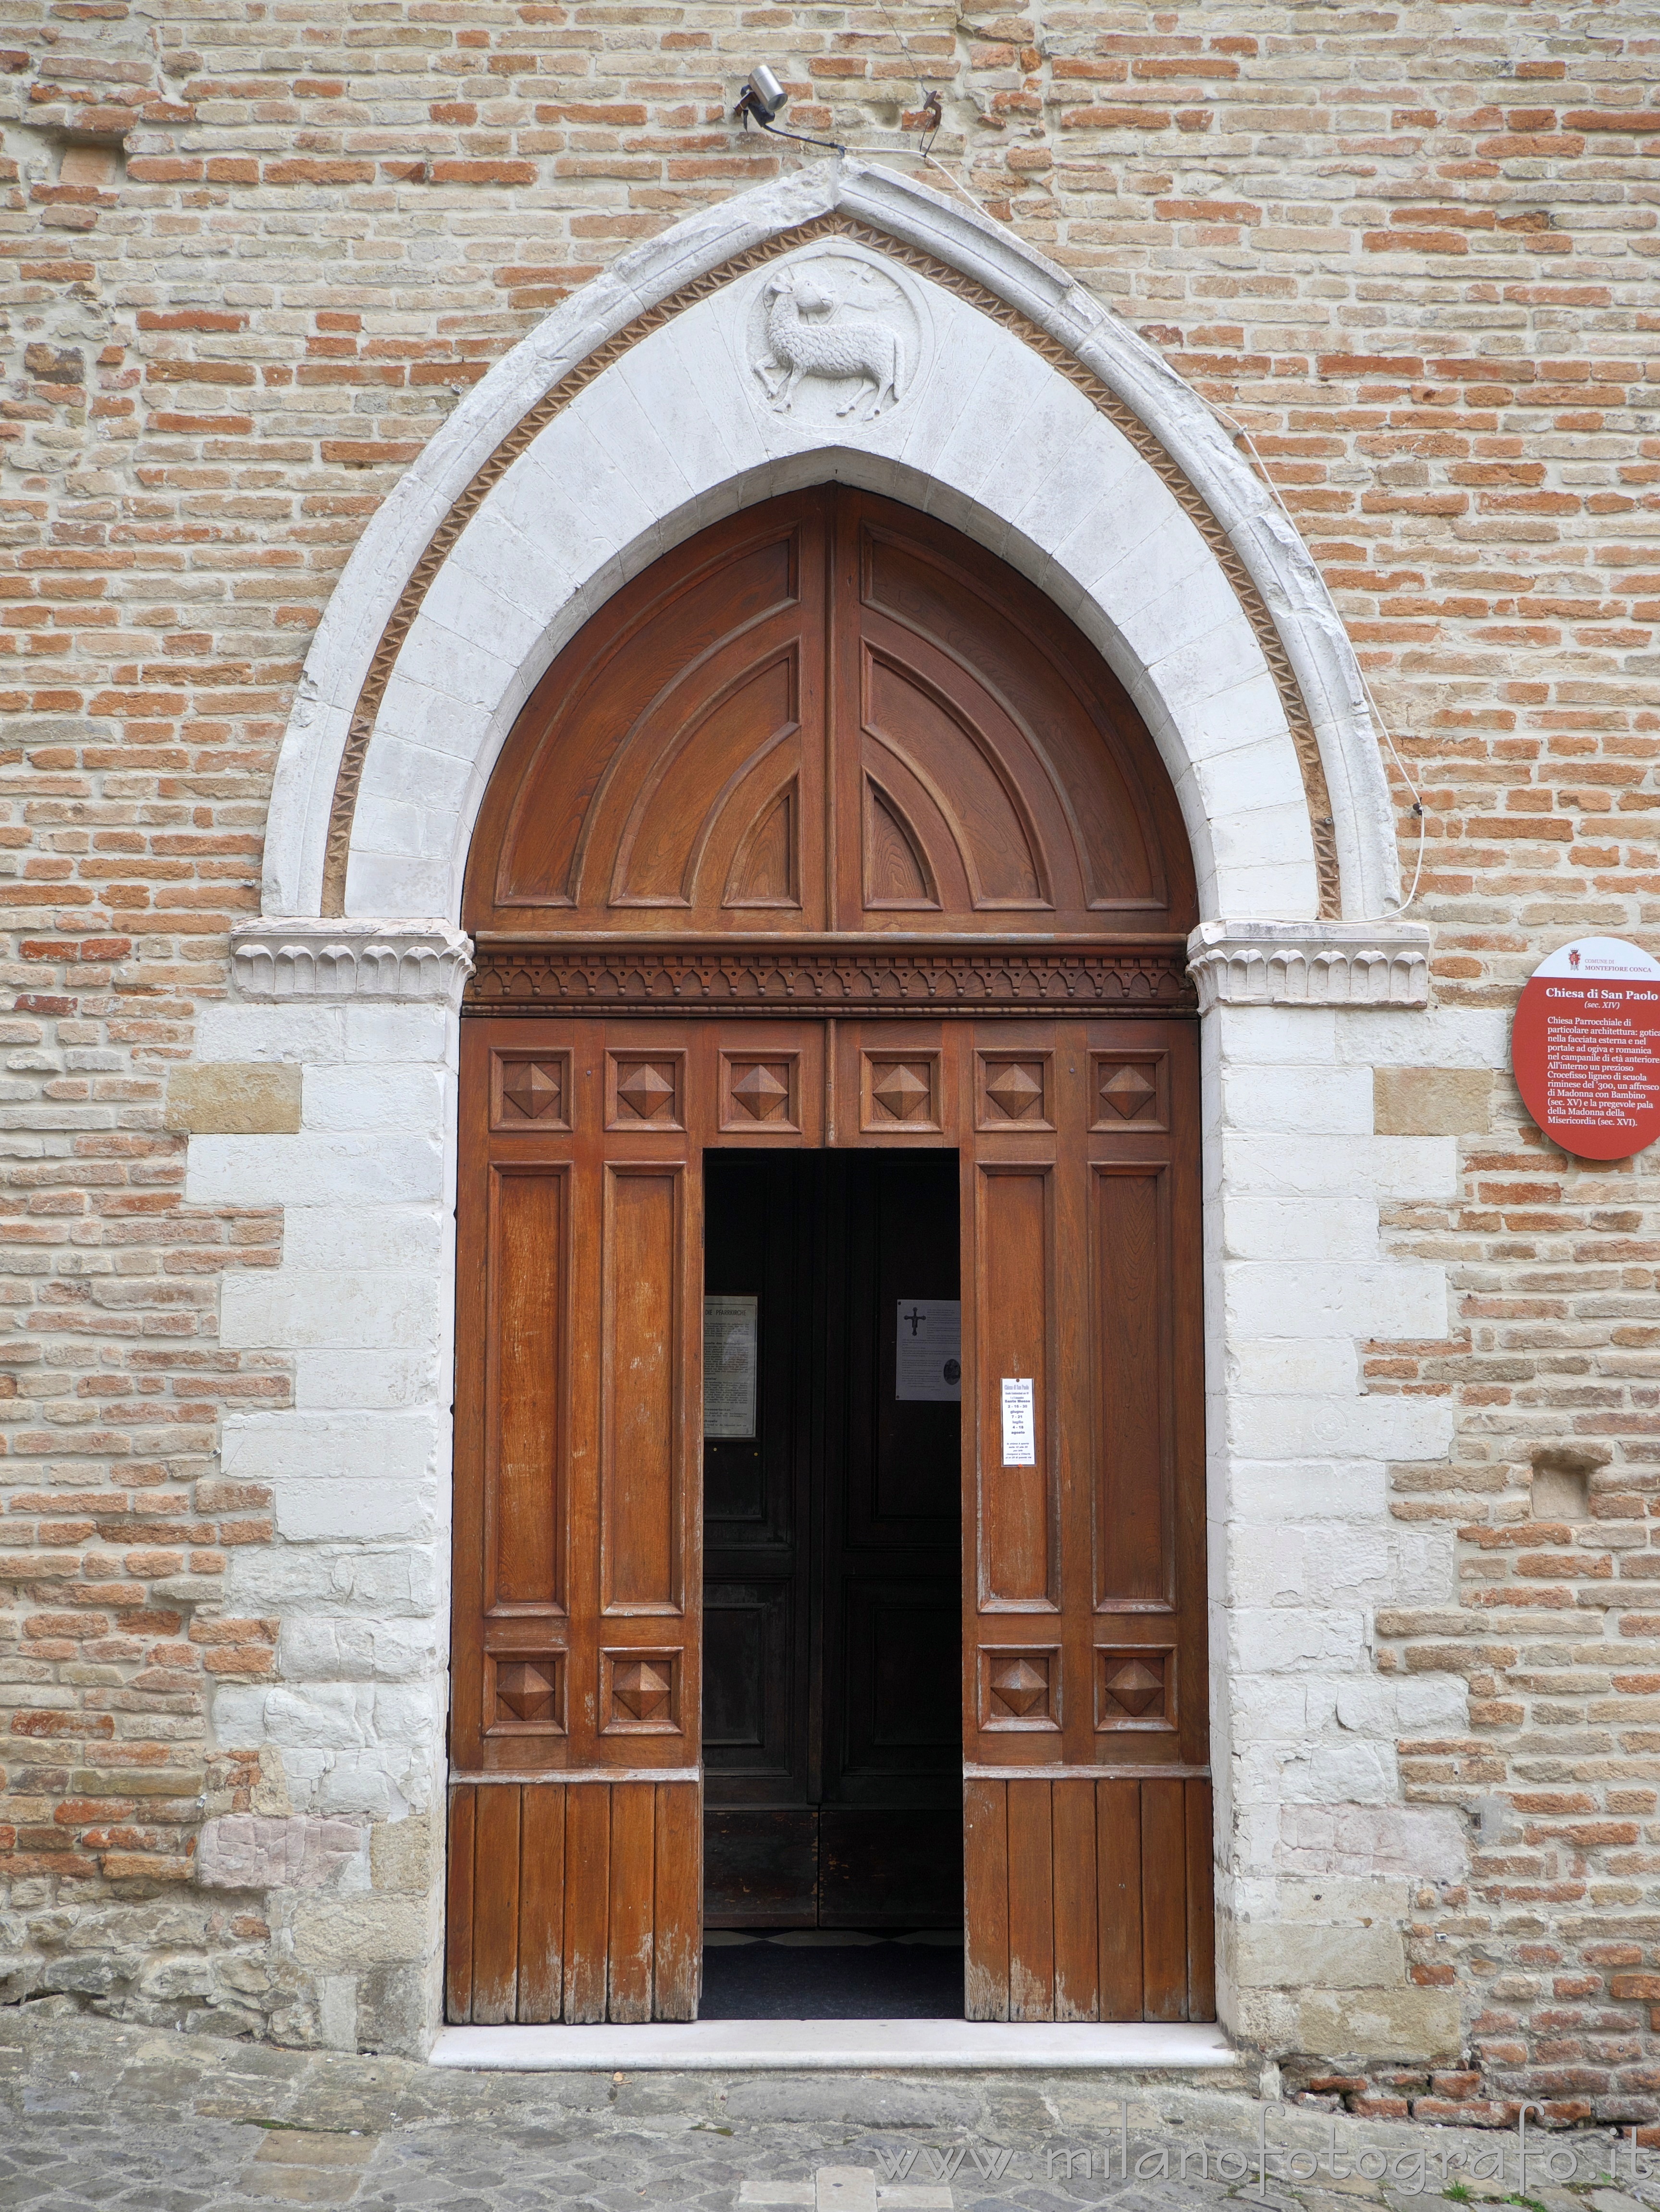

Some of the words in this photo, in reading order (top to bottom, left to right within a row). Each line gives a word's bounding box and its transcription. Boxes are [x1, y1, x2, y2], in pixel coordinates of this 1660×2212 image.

[1546, 988, 1585, 998] Chiesa
[1587, 989, 1599, 999] di
[1601, 990, 1623, 999] San
[1625, 990, 1659, 1001] Paolo
[1602, 1002, 1620, 1010] XIV)
[1548, 1016, 1573, 1025] Chiesa
[1575, 1017, 1622, 1026] Parrocchiale
[1548, 1026, 1589, 1034] particolare
[1590, 1027, 1637, 1036] architettura:
[1548, 1034, 1566, 1042] nella
[1568, 1035, 1597, 1043] facciata
[1548, 1044, 1575, 1052] portale
[1587, 1045, 1608, 1054] ogiva
[1561, 1054, 1600, 1063] campanile
[1547, 1062, 1588, 1070] All'interno
[1601, 1063, 1634, 1073] prezioso
[1547, 1071, 1587, 1079] Crocefisso
[1588, 1072, 1612, 1081] ligneo
[1548, 1079, 1581, 1088] riminese
[1596, 1081, 1616, 1090] '300,
[1629, 1082, 1660, 1090] affresco
[1557, 1089, 1594, 1098] Madonna
[1611, 1091, 1646, 1099] Bambino
[1548, 1098, 1565, 1106] (sec.
[1566, 1099, 1582, 1107] XV)
[1599, 1100, 1635, 1109] pregevole
[1636, 1101, 1654, 1110] pala
[1548, 1107, 1566, 1115] della
[1568, 1108, 1604, 1116] Madonna
[1606, 1109, 1625, 1117] della
[1548, 1116, 1596, 1125] Misericordia
[1598, 1117, 1615, 1126] (sec.
[1616, 1118, 1637, 1127] XVI).
